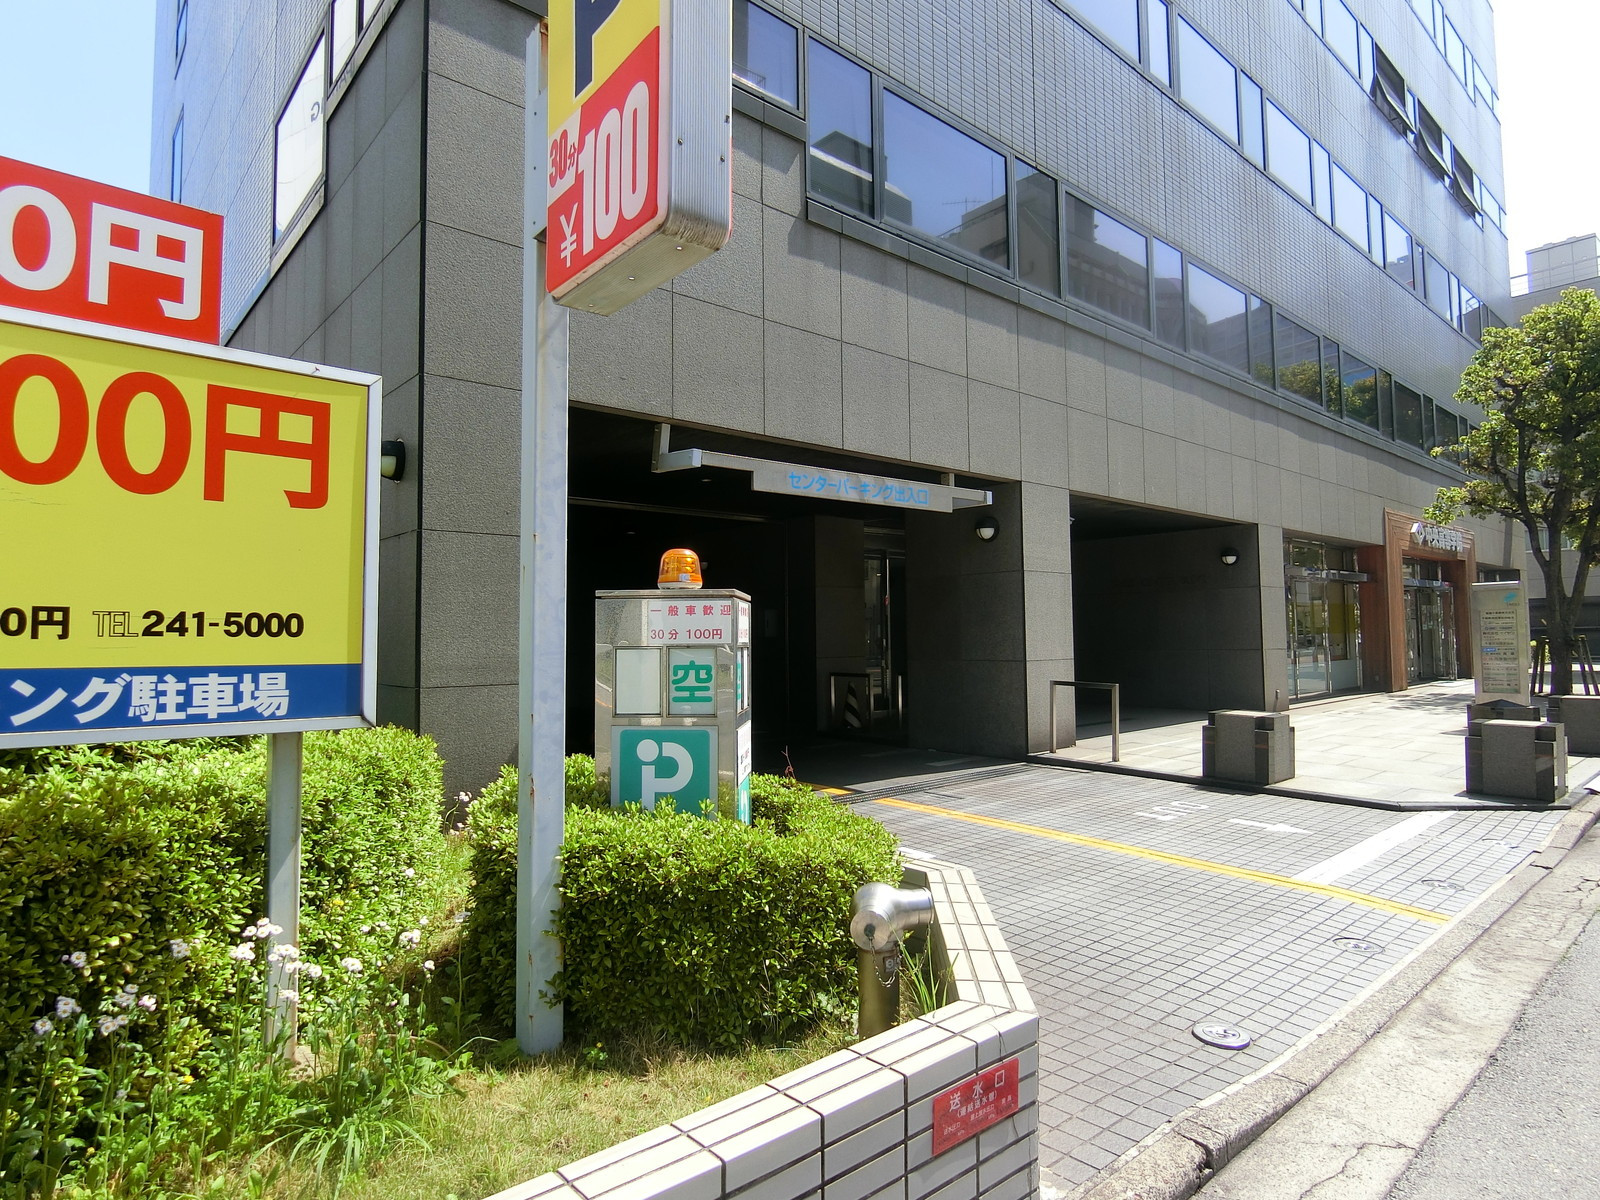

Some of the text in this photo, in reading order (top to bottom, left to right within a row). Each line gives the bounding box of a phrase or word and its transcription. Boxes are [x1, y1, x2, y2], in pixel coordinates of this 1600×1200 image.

[549, 129, 578, 188] 30分
[788, 471, 929, 505] センターパーキング出入口
[650, 604, 731, 617] 一般車歓迎
[10, 672, 290, 727] ング駐車場
[671, 660, 713, 703] 空
[949, 1069, 1005, 1112] 送水口
